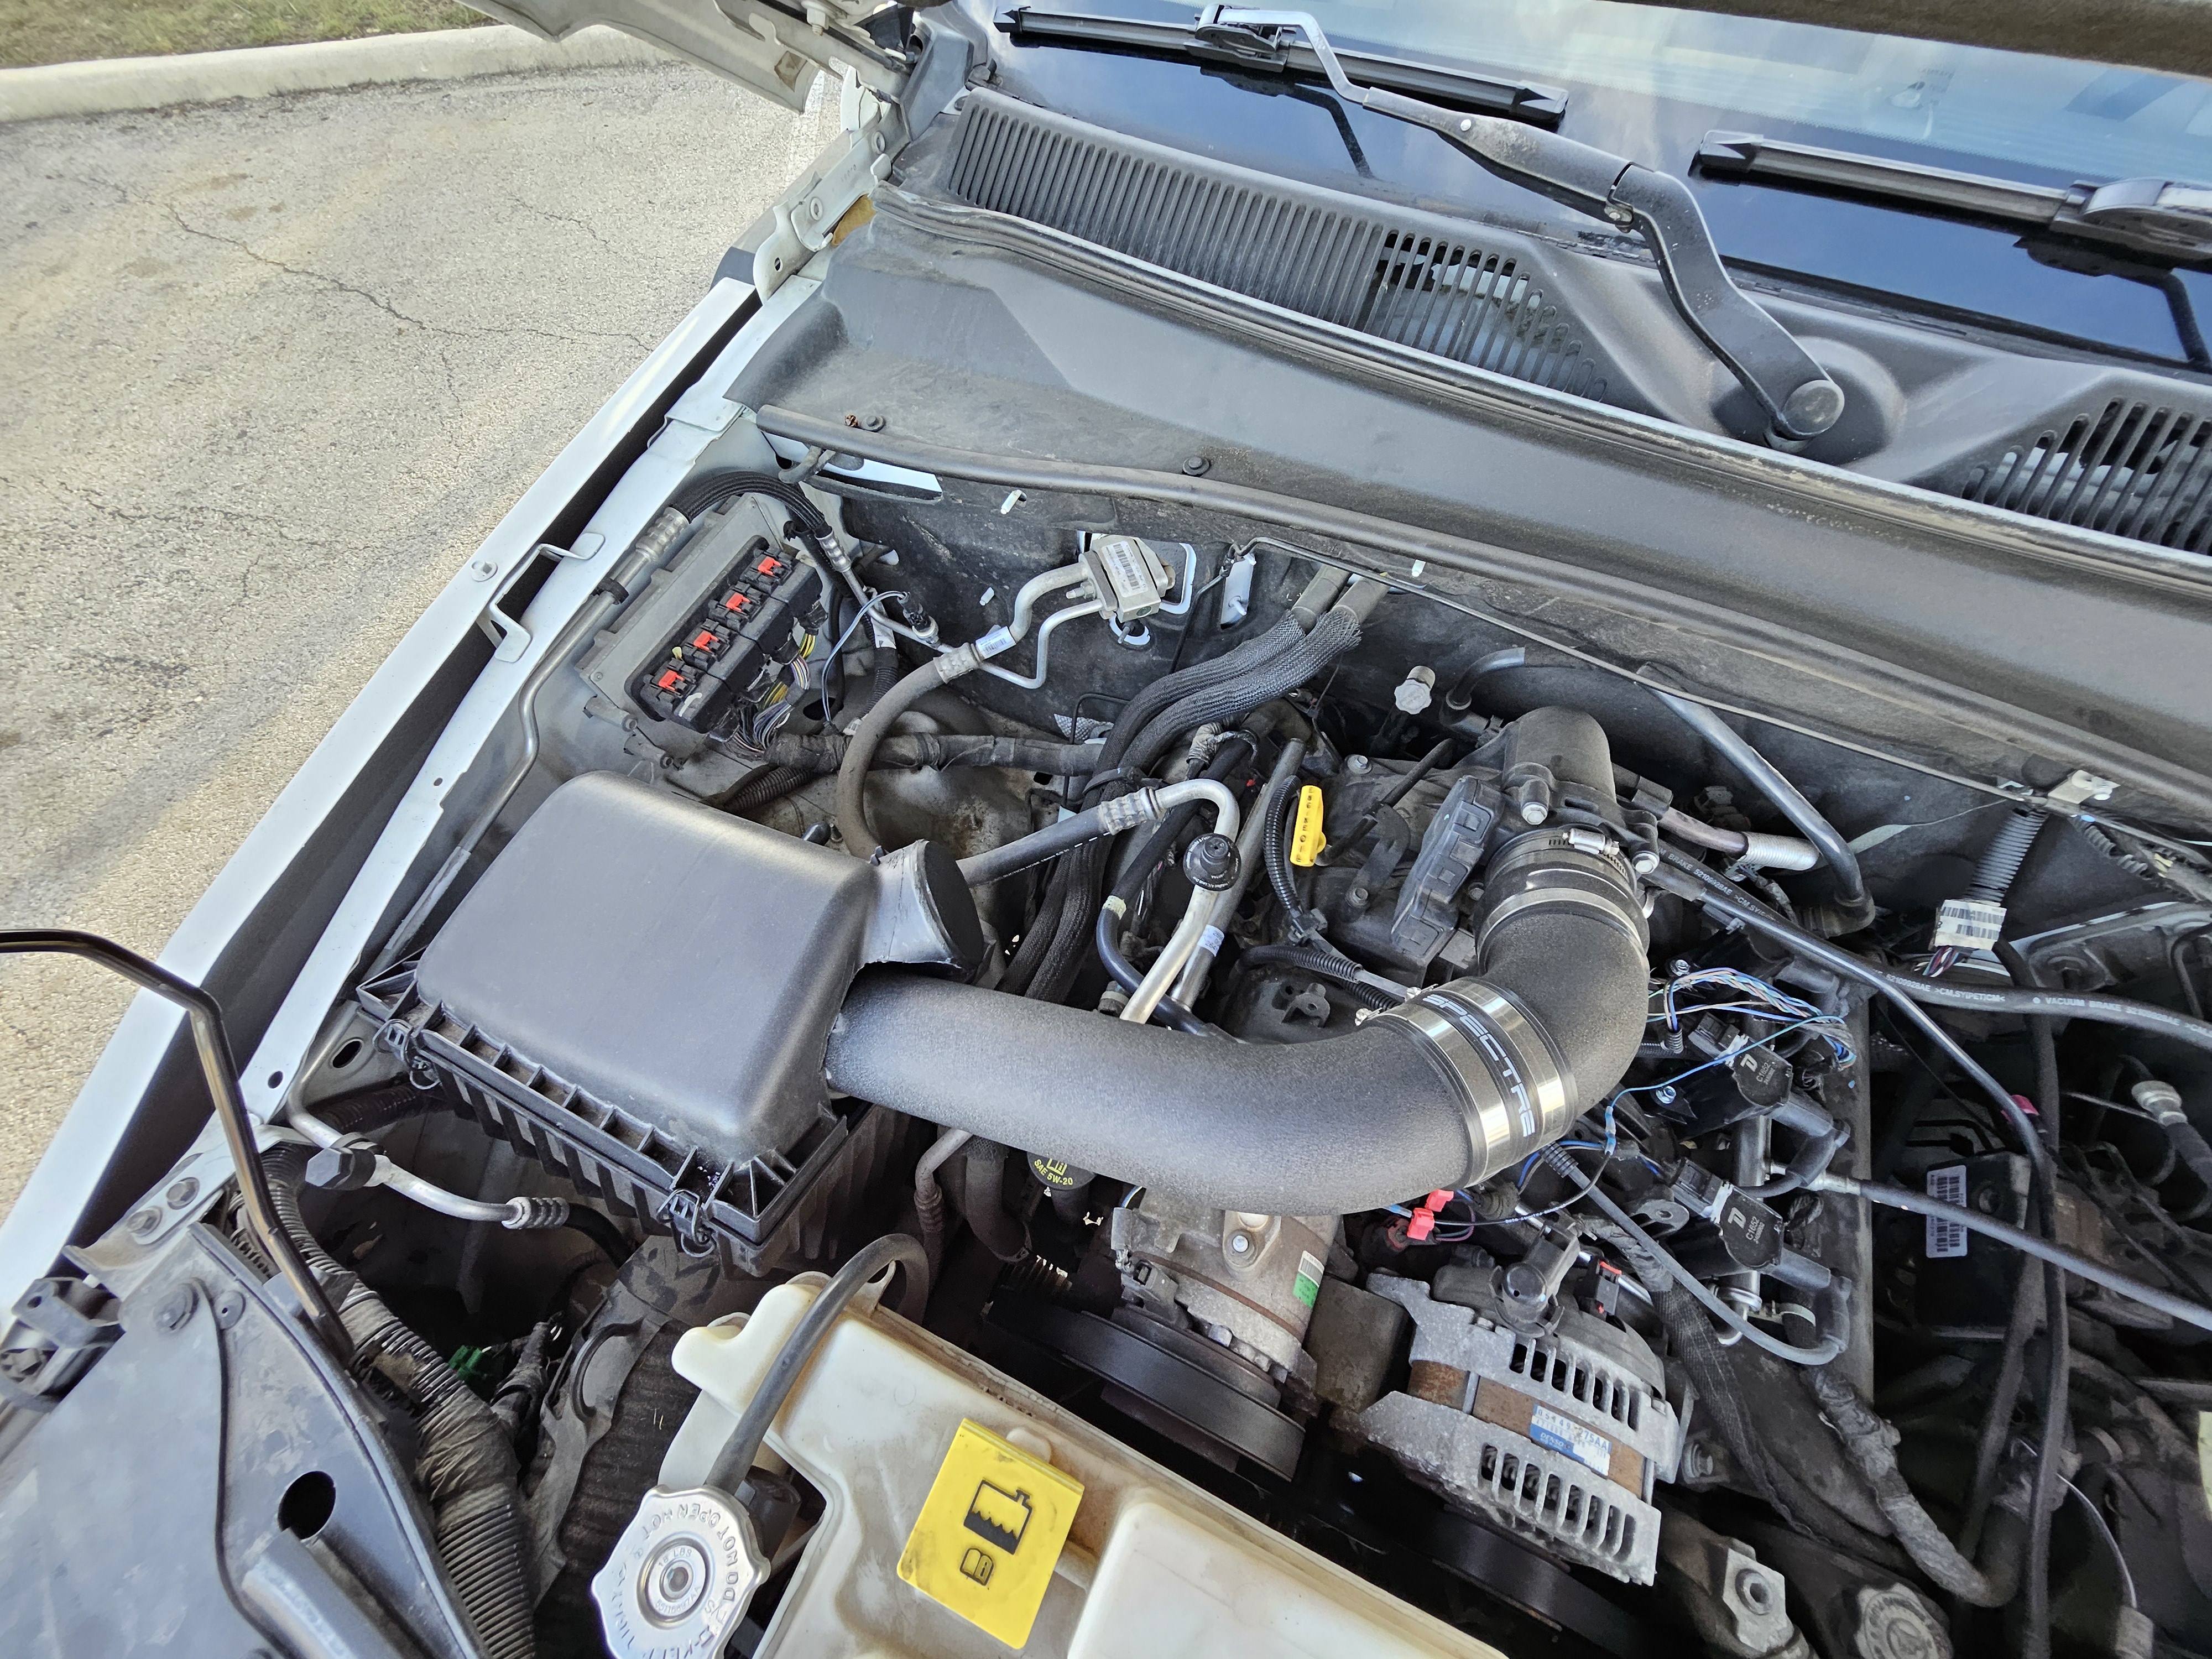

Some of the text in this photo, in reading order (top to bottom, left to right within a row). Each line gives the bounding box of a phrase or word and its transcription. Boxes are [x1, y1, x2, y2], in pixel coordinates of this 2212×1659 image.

[1302, 787, 1315, 831] ENGINE
[1668, 853, 1693, 871] BRAKE
[2045, 997, 2085, 1006] VACUUM
[2089, 1000, 2122, 1011] BRAKE
[1422, 994, 1535, 1138] SPECTRE
[1756, 1062, 1771, 1082] C1652
[1034, 1159, 1073, 1185] SAE 5W-20
[1745, 1216, 1760, 1240] C1652
[1540, 1432, 1564, 1447] DENSO
[641, 1503, 739, 1601] DO NOT OPEN HOT
[658, 1547, 692, 1567] 18 LBS
